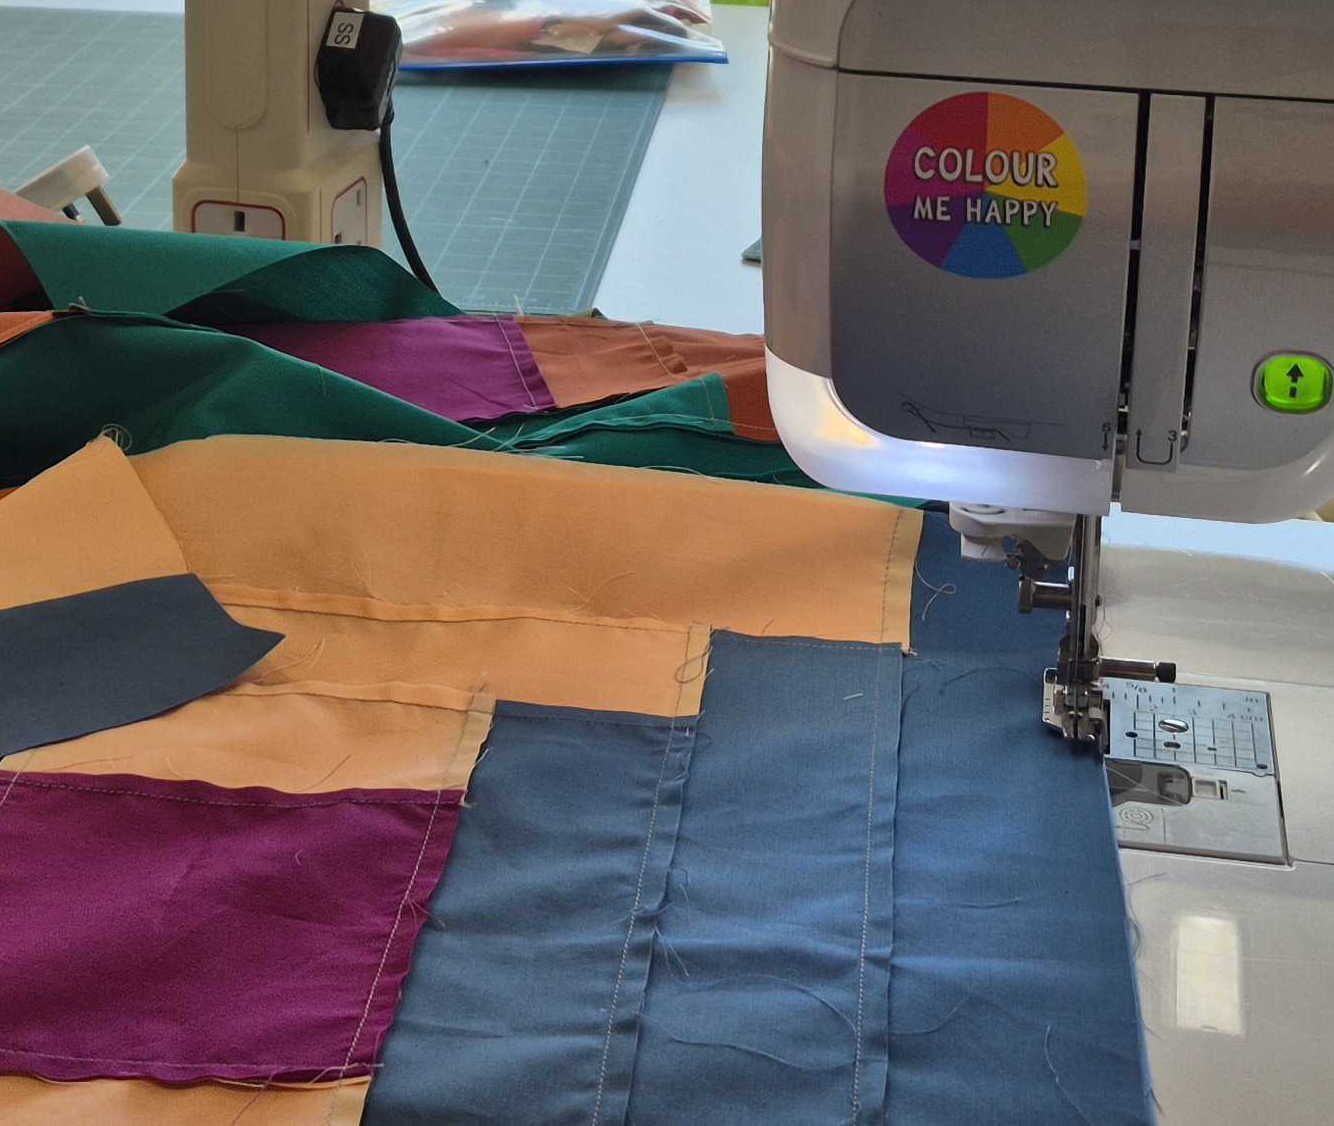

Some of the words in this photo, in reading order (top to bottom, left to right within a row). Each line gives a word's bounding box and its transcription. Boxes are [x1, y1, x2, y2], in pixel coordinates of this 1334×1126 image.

[334, 22, 354, 45] SS
[913, 145, 1059, 188] COLOUR
[912, 194, 952, 222] ME
[966, 196, 1059, 228] HAPPY
[1168, 429, 1178, 442] 3
[1188, 708, 1197, 716] 3
[1240, 714, 1264, 722] cm
